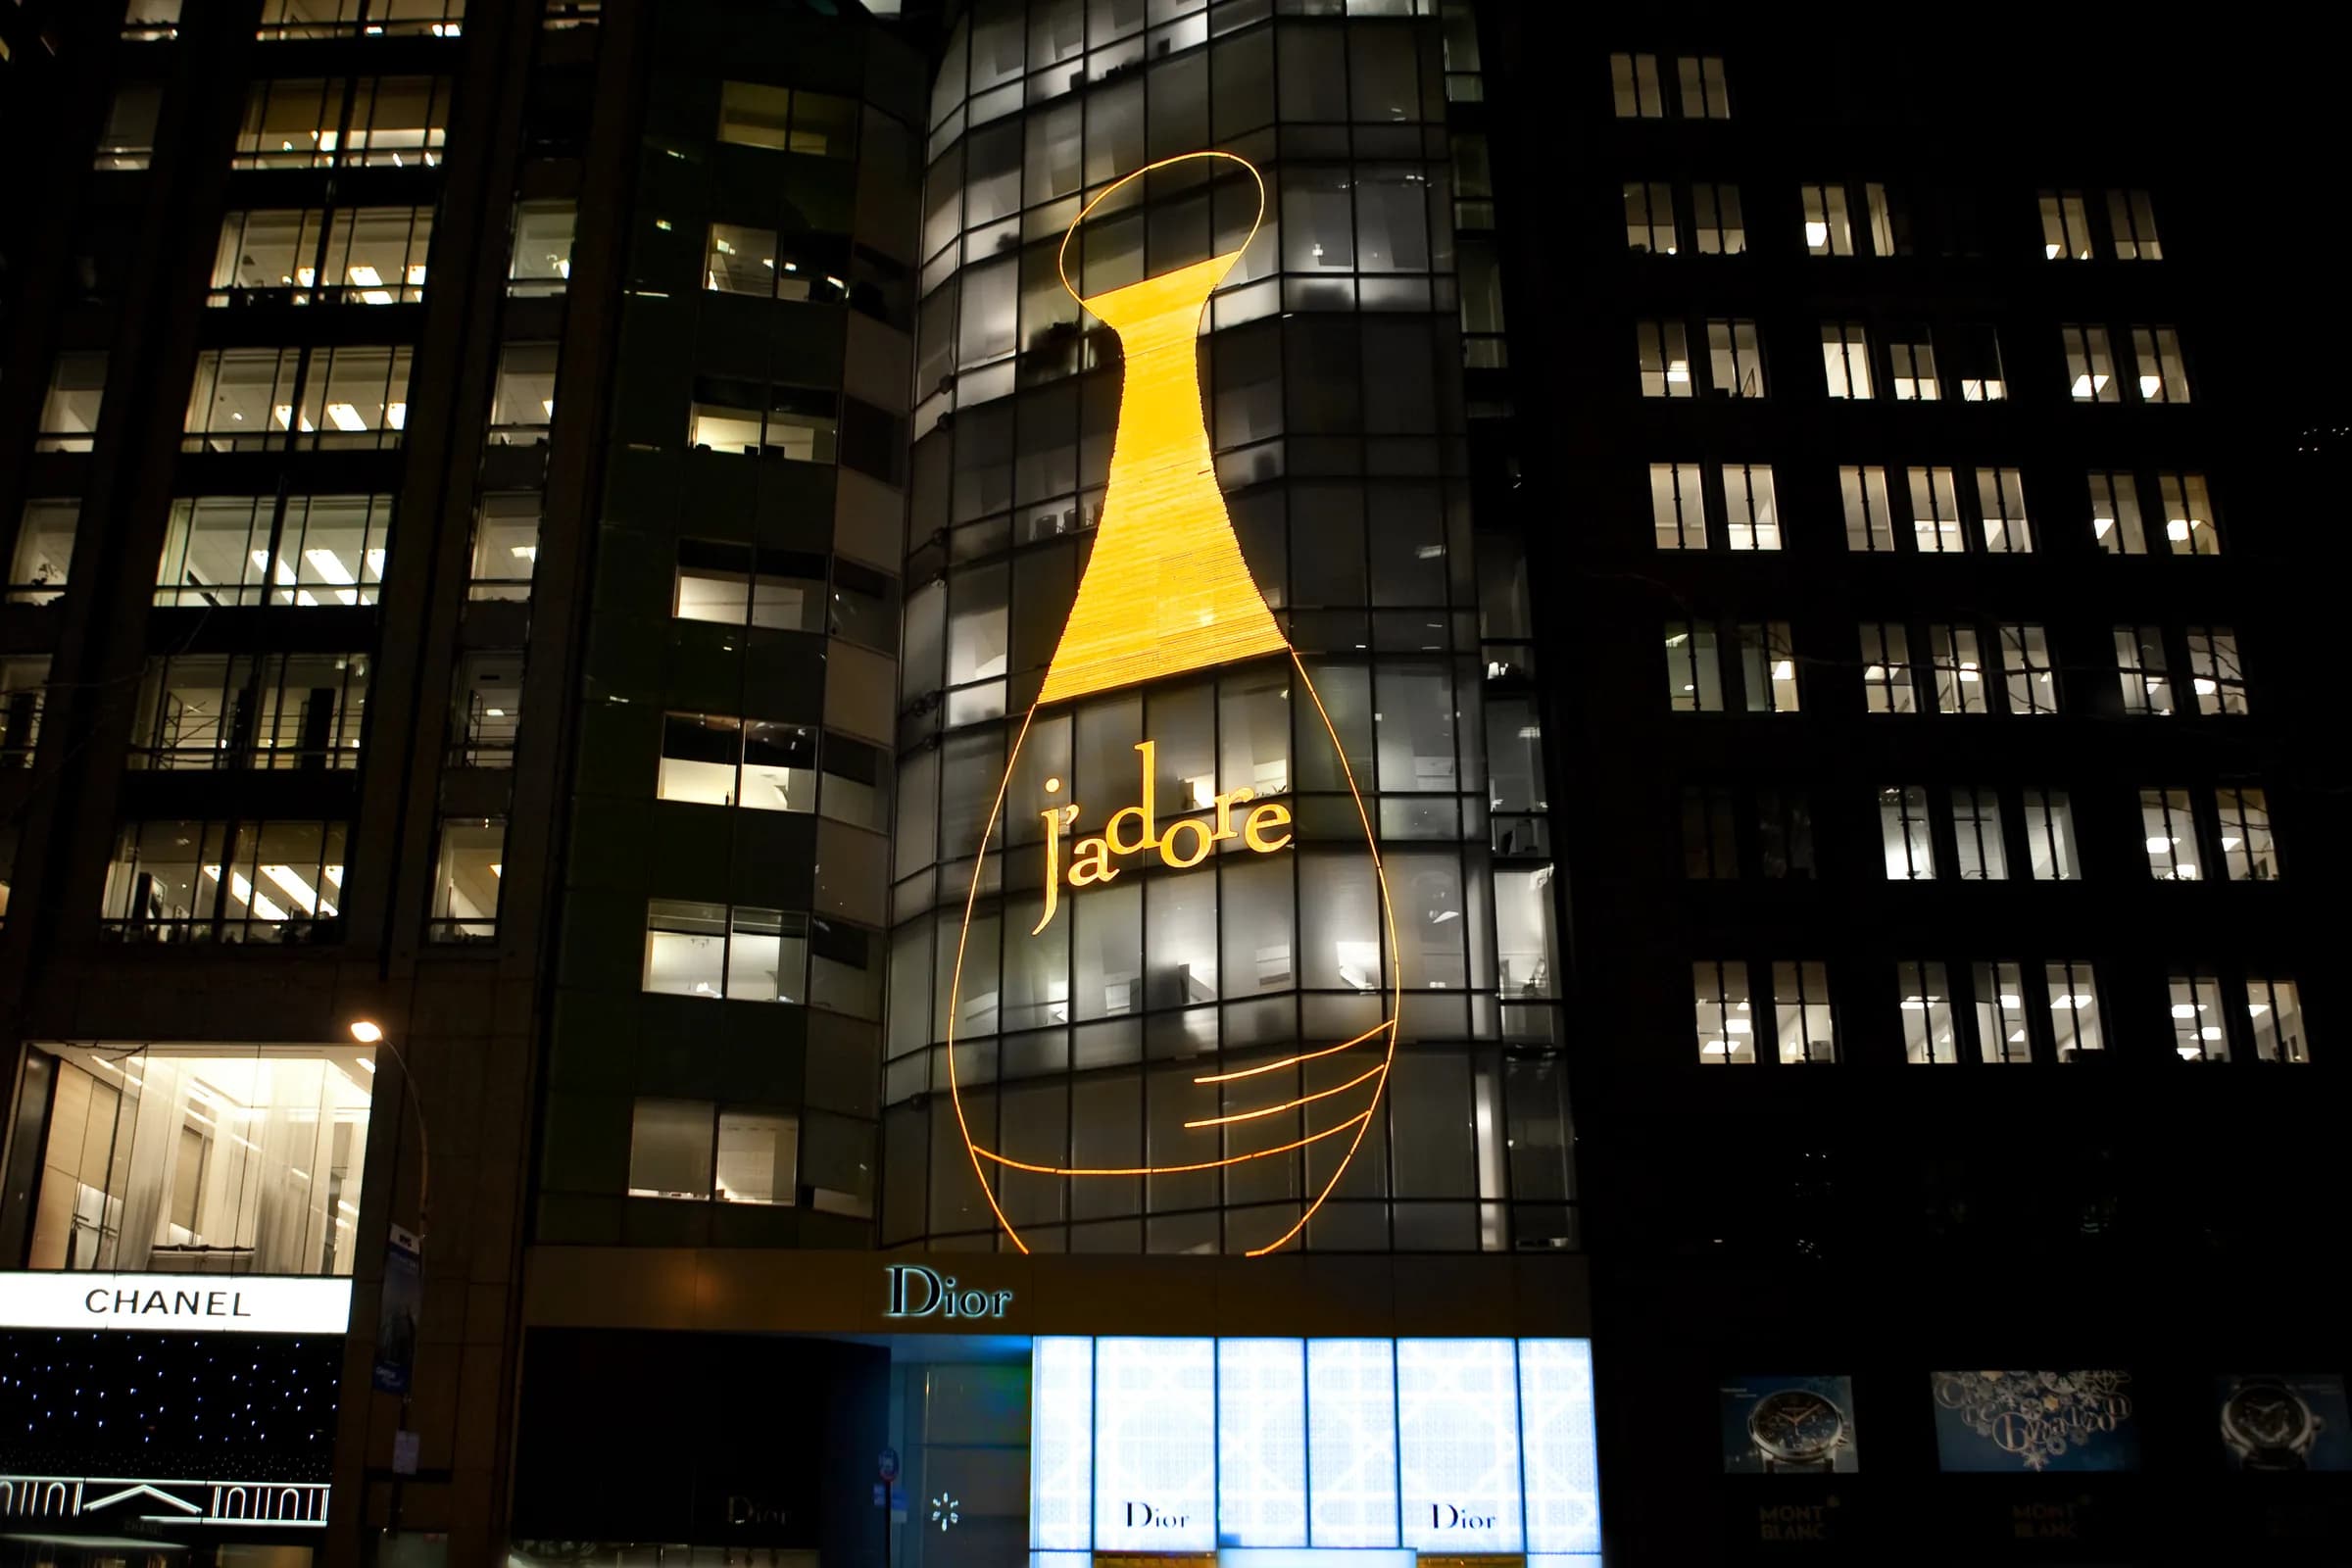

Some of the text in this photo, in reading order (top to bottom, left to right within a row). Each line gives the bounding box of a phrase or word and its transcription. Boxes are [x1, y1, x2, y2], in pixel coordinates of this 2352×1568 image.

[1032, 740, 1293, 936] j'adore
[85, 1289, 251, 1316] CHANEL
[884, 1264, 1012, 1317] Dior
[1125, 1500, 1190, 1528] Dior
[1430, 1502, 1495, 1529] Dior
[1759, 1505, 1826, 1522] MONT
[1760, 1522, 1827, 1541] BLANC
